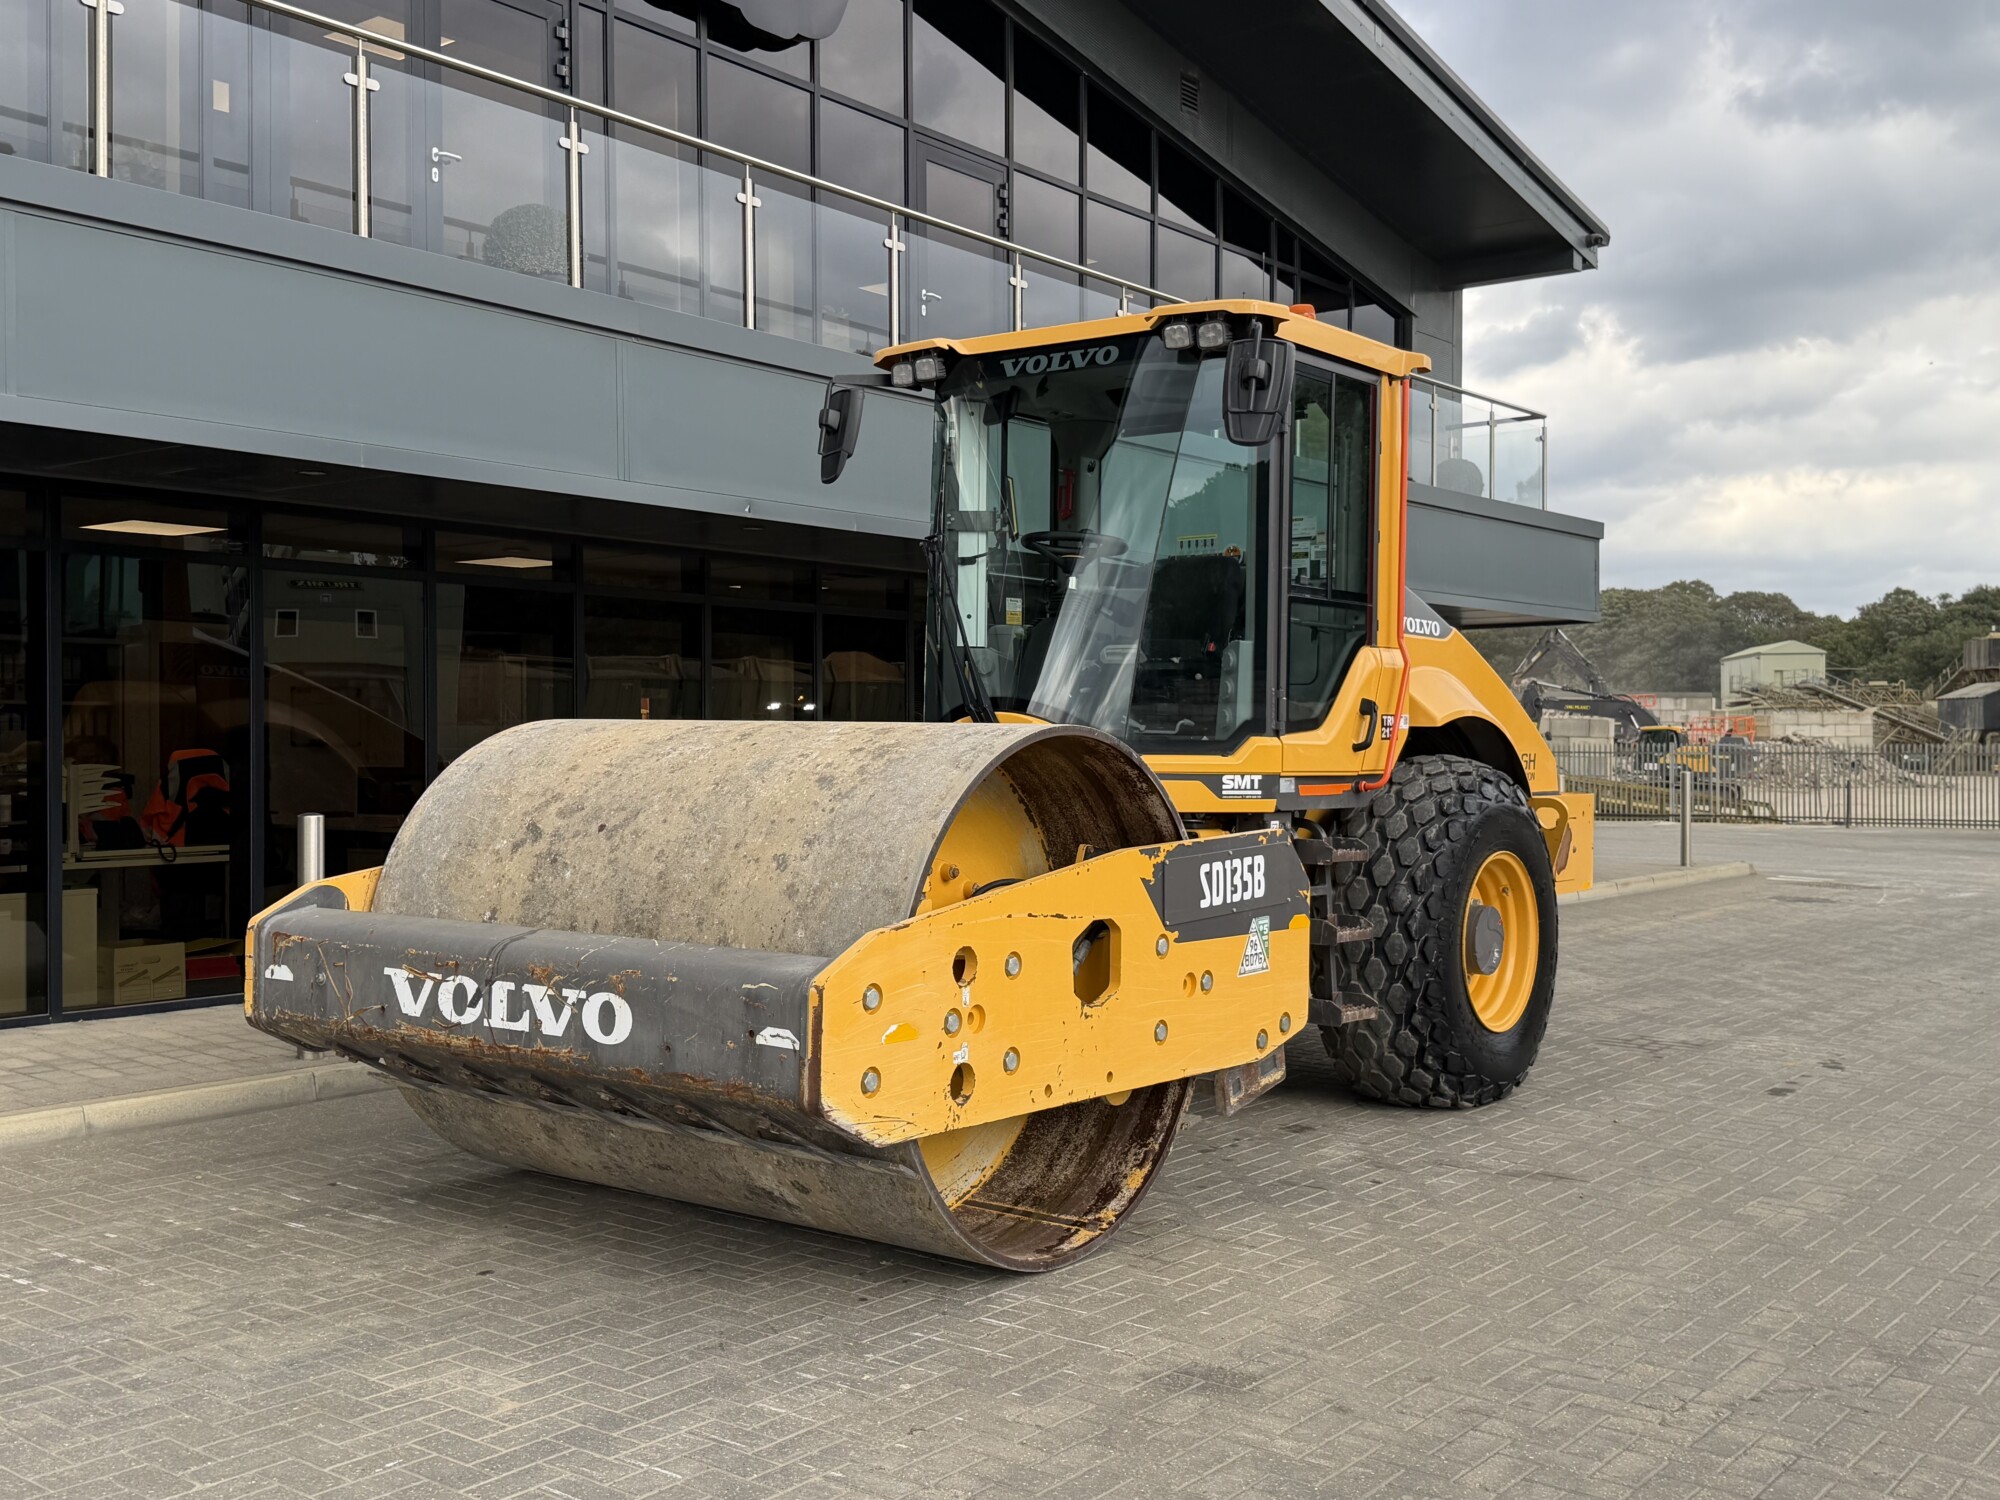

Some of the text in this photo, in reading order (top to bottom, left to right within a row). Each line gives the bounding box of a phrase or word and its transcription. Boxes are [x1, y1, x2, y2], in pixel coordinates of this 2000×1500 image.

[1000, 345, 1120, 377] VOLVO
[1222, 775, 1262, 789] SMT
[1200, 855, 1265, 908] SD135B
[384, 967, 633, 1045] VOLVO
